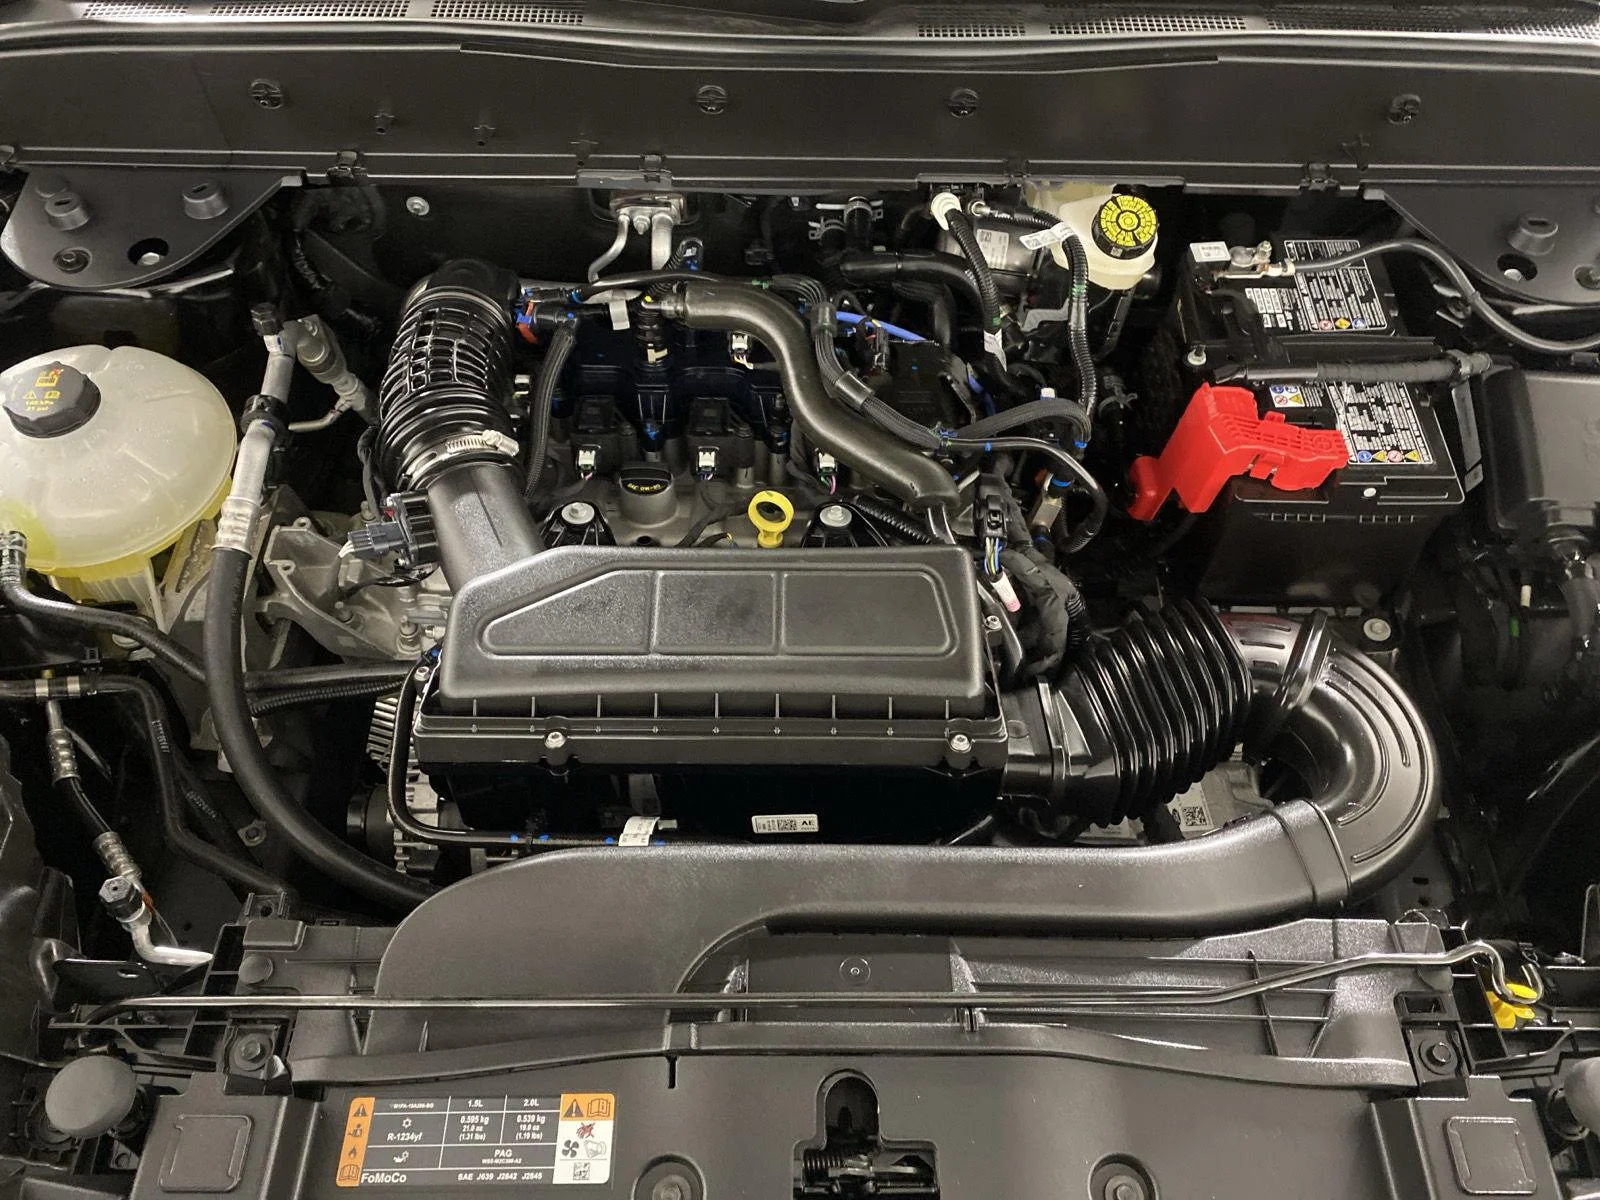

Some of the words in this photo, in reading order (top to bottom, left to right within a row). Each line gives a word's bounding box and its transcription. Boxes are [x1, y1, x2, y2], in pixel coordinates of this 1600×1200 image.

[467, 1099, 484, 1108] 1.5L
[523, 1098, 540, 1107] 2.0L
[479, 1115, 490, 1125] kg
[535, 1114, 546, 1125] kg
[386, 1132, 424, 1143] R-1234yf
[494, 1149, 513, 1158] PAG
[360, 1172, 407, 1183] FoMoCo
